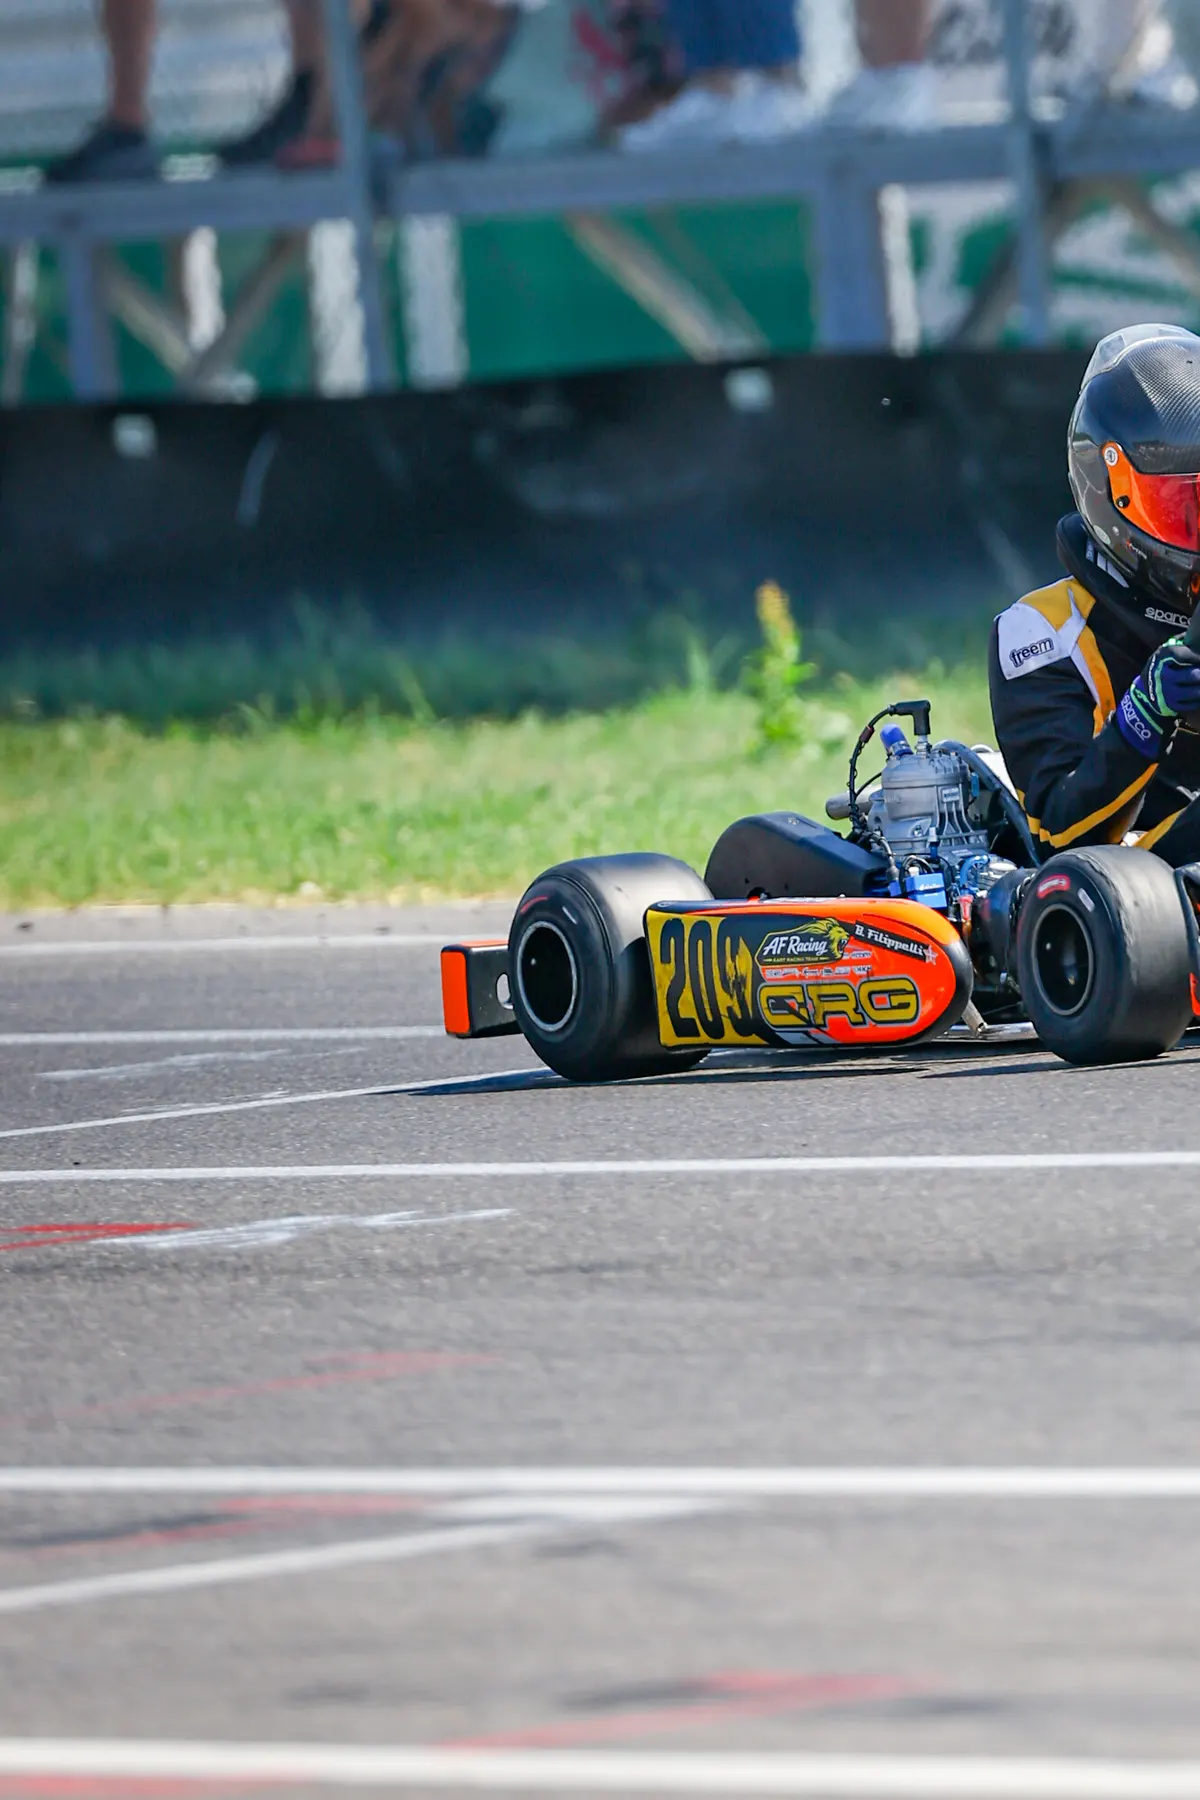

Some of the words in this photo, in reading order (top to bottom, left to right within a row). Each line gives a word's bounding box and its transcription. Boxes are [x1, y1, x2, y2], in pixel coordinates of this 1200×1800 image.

[1009, 637, 1055, 668] freem
[1121, 695, 1152, 740] sparco
[763, 936, 789, 956] AF
[787, 935, 829, 956] Racing
[855, 924, 865, 937] B.
[867, 928, 924, 956] Filippelli
[758, 975, 920, 1031] CRG
